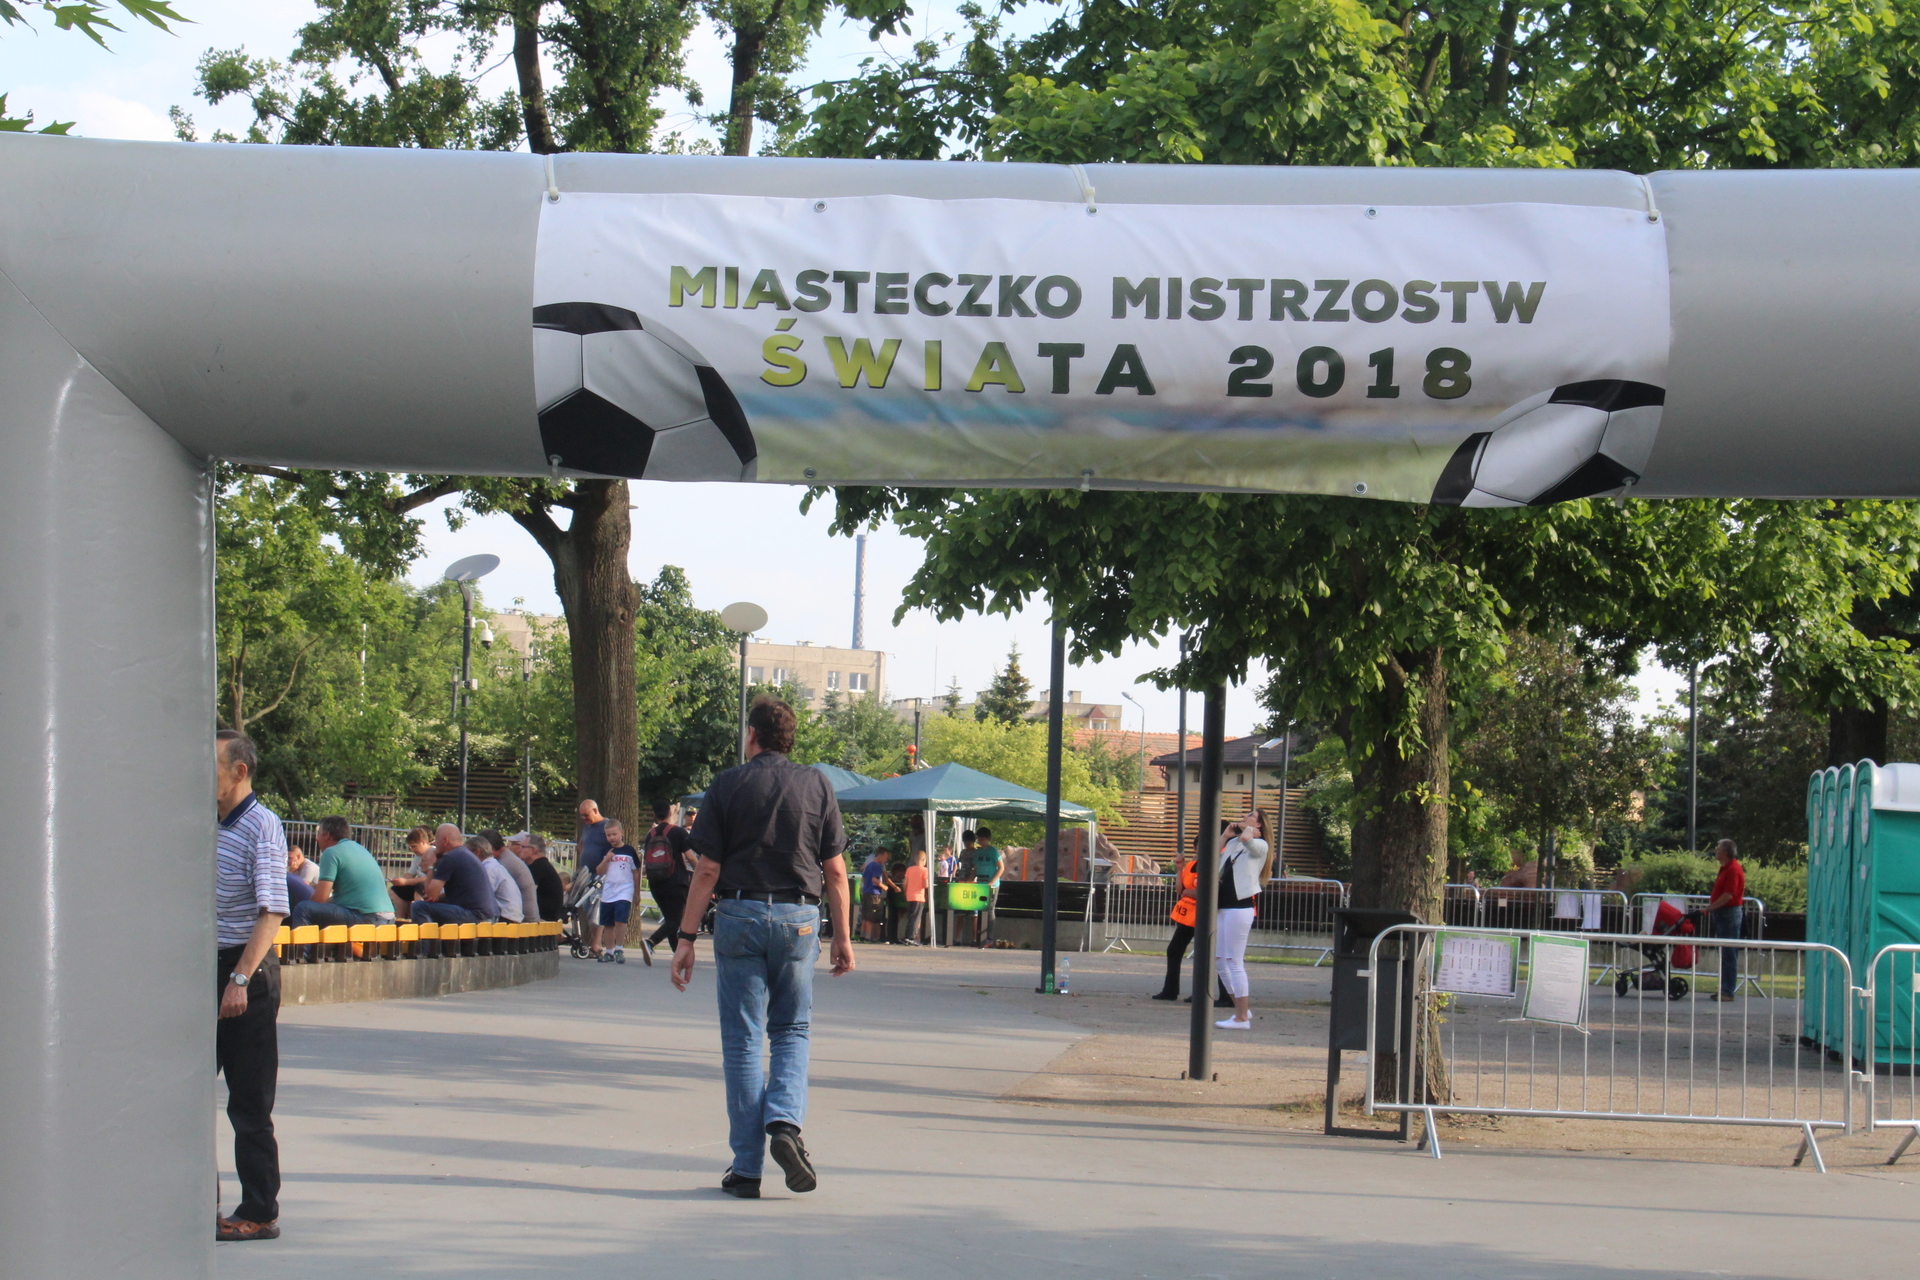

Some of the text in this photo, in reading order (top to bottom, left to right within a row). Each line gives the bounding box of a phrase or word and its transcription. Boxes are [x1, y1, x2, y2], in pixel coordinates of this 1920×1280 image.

[668, 265, 1547, 324] MIASTECZKO MISTRZOSTW
[759, 317, 1472, 400] ŚWIATA 2018
